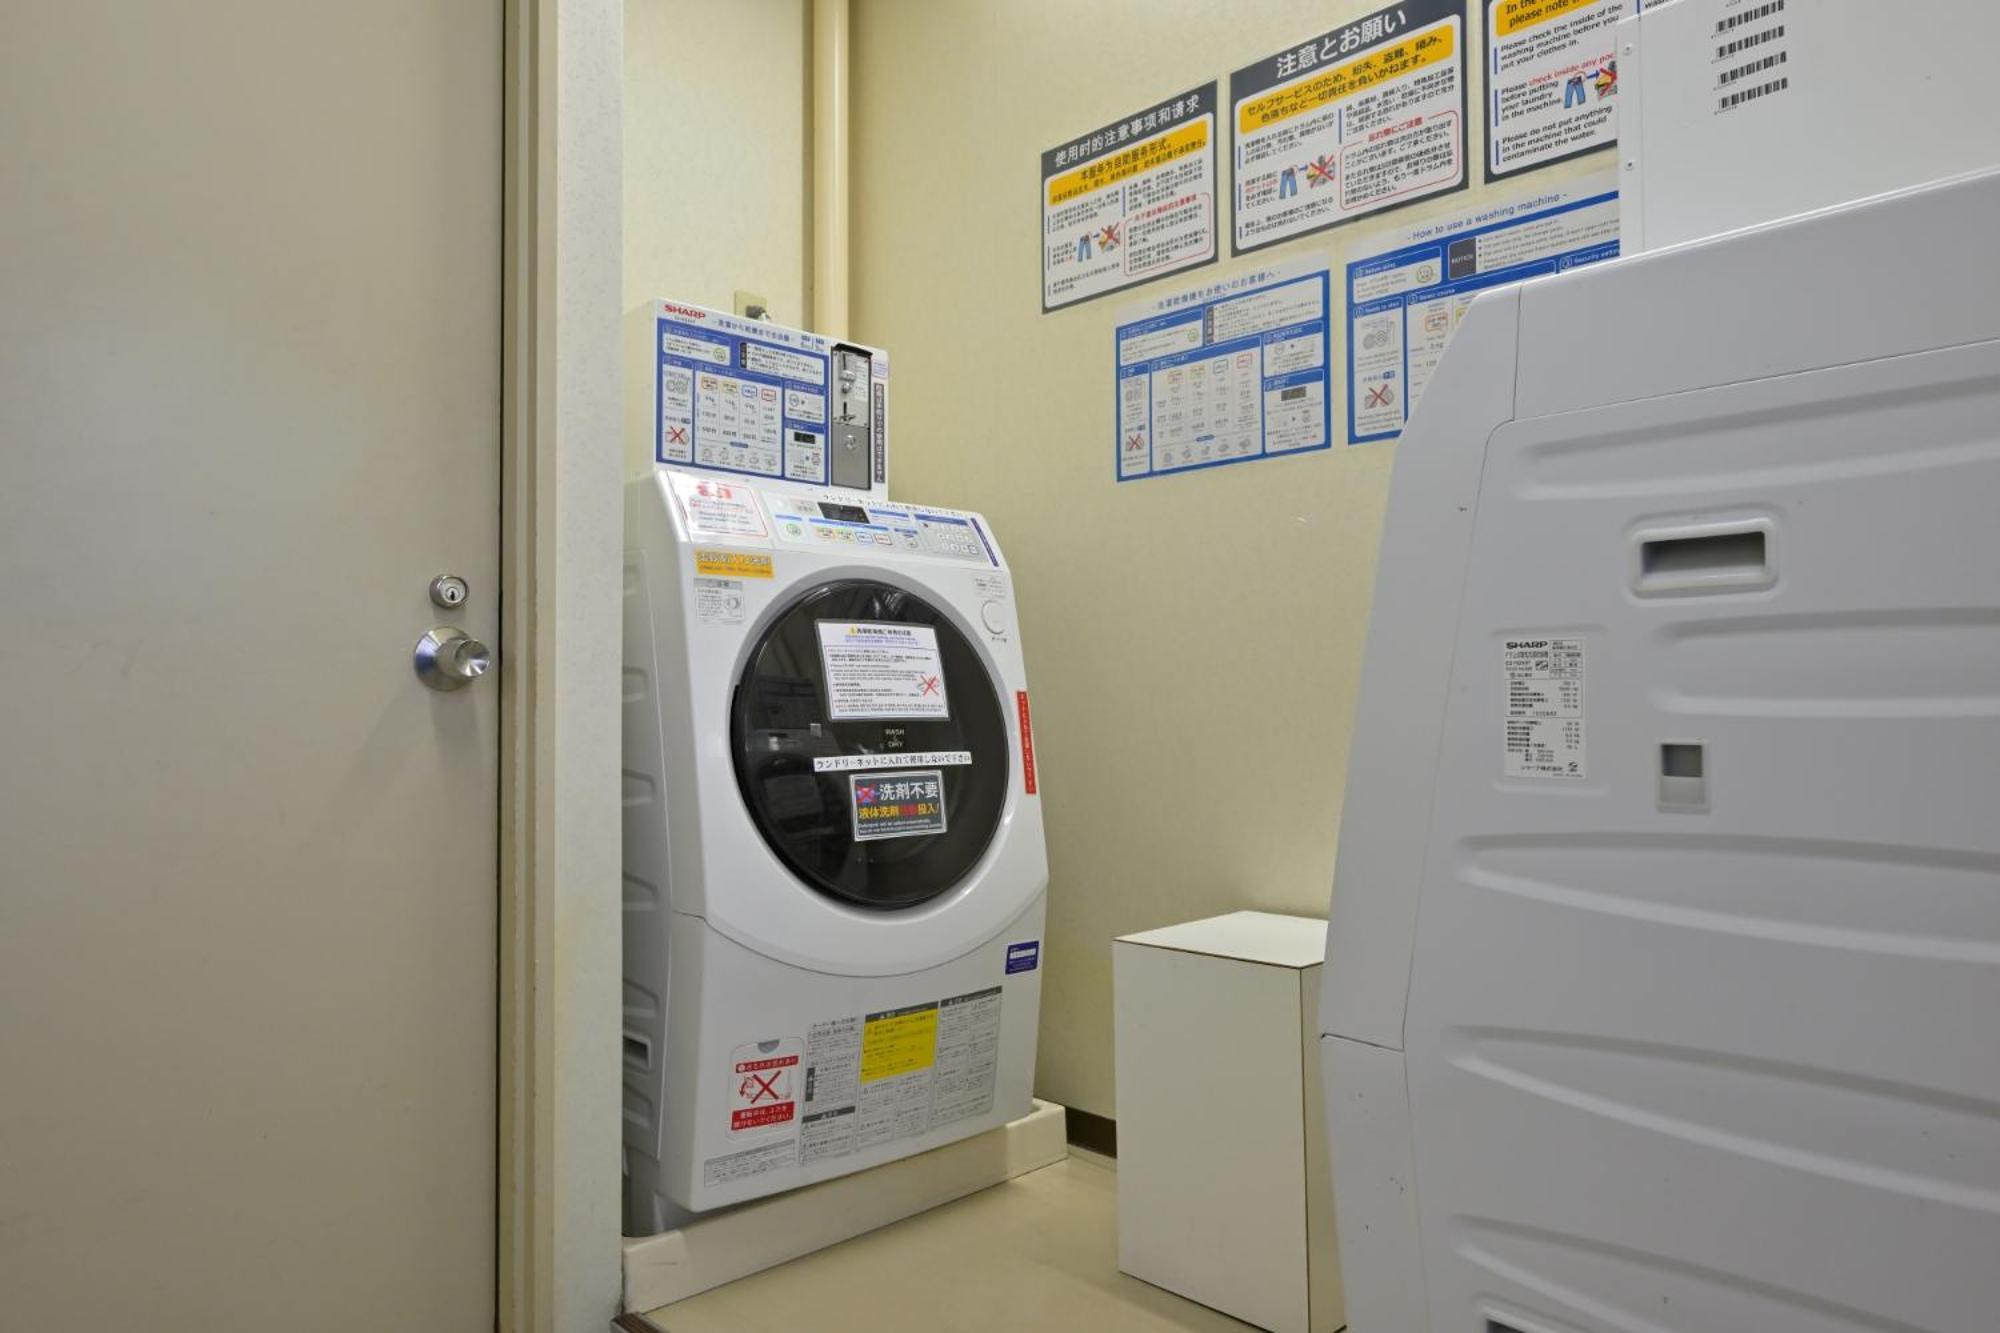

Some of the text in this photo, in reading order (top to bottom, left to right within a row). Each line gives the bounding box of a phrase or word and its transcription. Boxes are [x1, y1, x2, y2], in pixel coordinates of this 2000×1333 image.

[1506, 3, 1517, 14] In
[1509, 1, 1568, 28] please note
[1501, 4, 1623, 52] Please check the inside of the
[1275, 10, 1407, 79] 注意とお願い
[1501, 46, 1534, 61] washing
[1536, 34, 1570, 48] machine
[1573, 23, 1600, 36] before
[1501, 61, 1515, 72] put
[1517, 55, 1534, 67] your
[1537, 43, 1567, 57] clothes
[1501, 82, 1527, 95] Please
[1528, 73, 1552, 86] check
[1554, 65, 1579, 78] inside
[1581, 58, 1597, 70] any
[1501, 81, 1559, 104] before putting
[1501, 91, 1553, 113] your laundry
[1502, 105, 1613, 144] Please do not put anything
[1511, 109, 1525, 119] the
[1054, 94, 1201, 168] 使用时的注意事项和请求
[1502, 115, 1607, 153] in the machine that could
[1502, 143, 1553, 162] contaminate
[1554, 137, 1569, 147] the
[1413, 194, 1560, 240] How to use a washing machine
[664, 304, 706, 319] SHARP
[1506, 641, 1548, 649] SHARP
[886, 728, 905, 736] WASH
[880, 782, 938, 800] 洗剤不要
